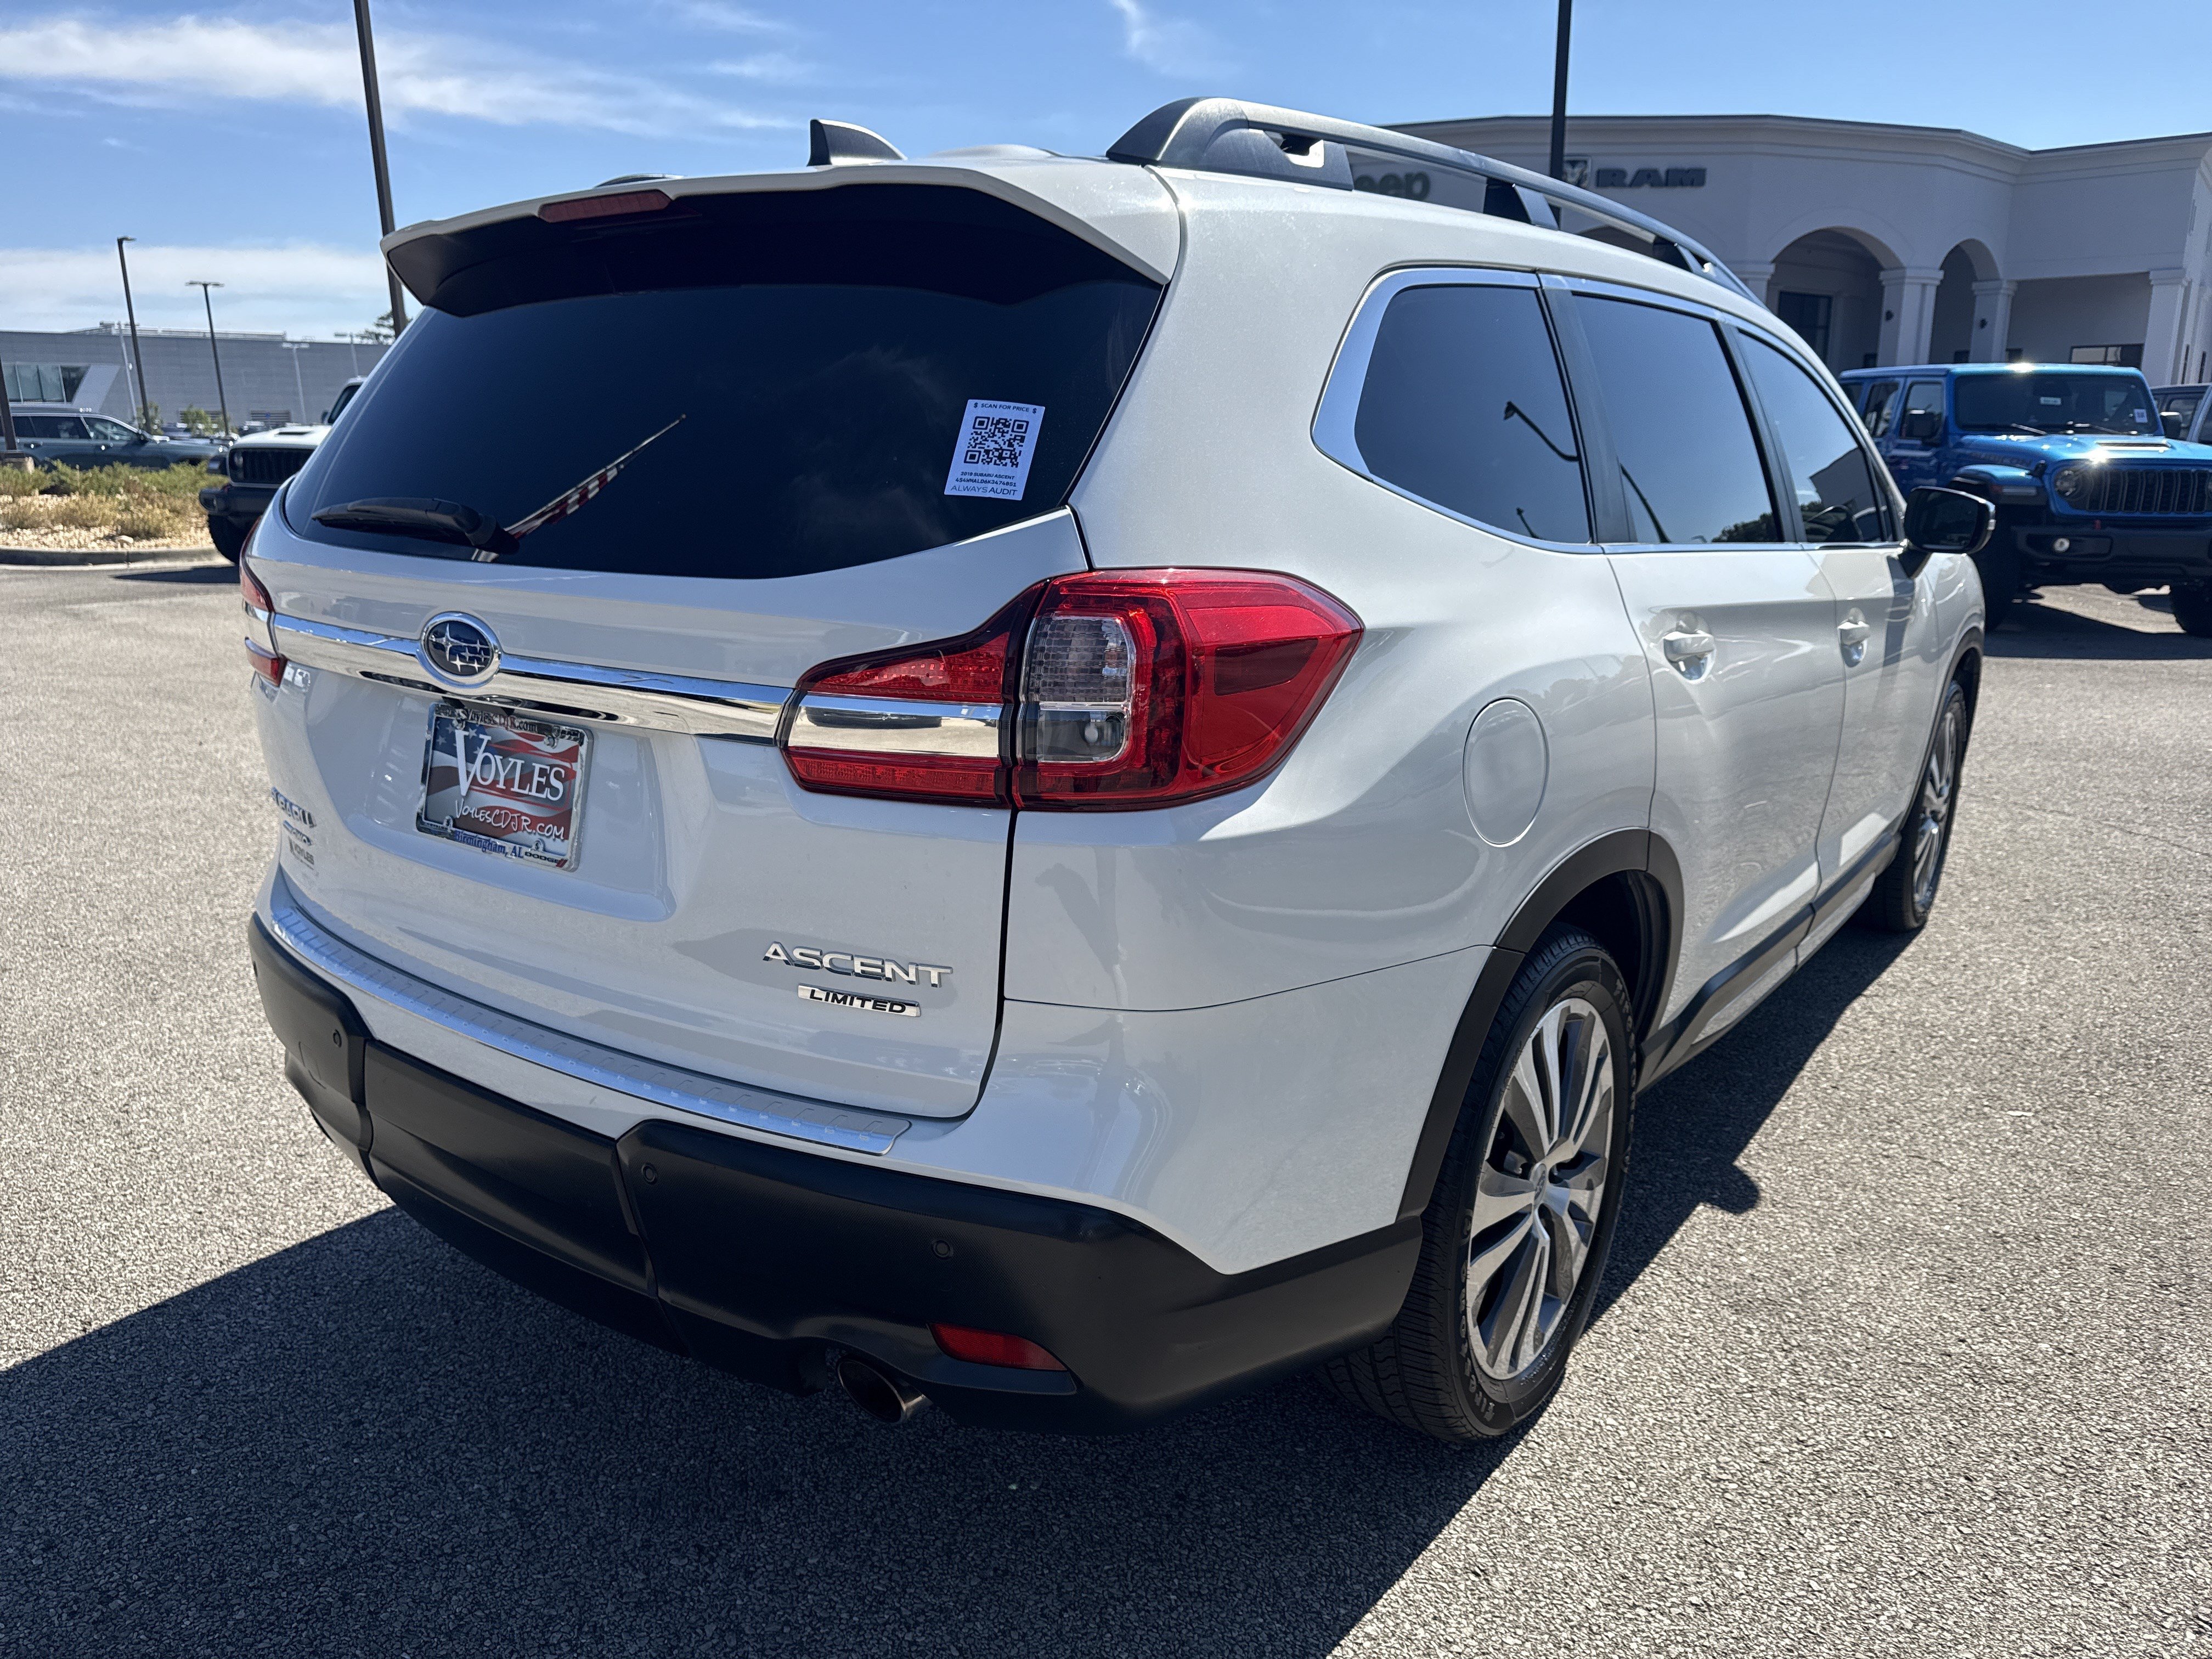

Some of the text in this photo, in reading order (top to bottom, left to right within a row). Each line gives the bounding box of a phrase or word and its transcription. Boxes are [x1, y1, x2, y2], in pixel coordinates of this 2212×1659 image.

[1355, 173, 1430, 201] eep
[1595, 167, 1707, 188] RAM
[950, 485, 1018, 495] ALWAYS AUDIT
[455, 730, 565, 801] VOYLES
[453, 830, 524, 859] Birmingham, AL
[763, 941, 953, 988] ASCENT
[809, 989, 906, 1013] LIMITED
